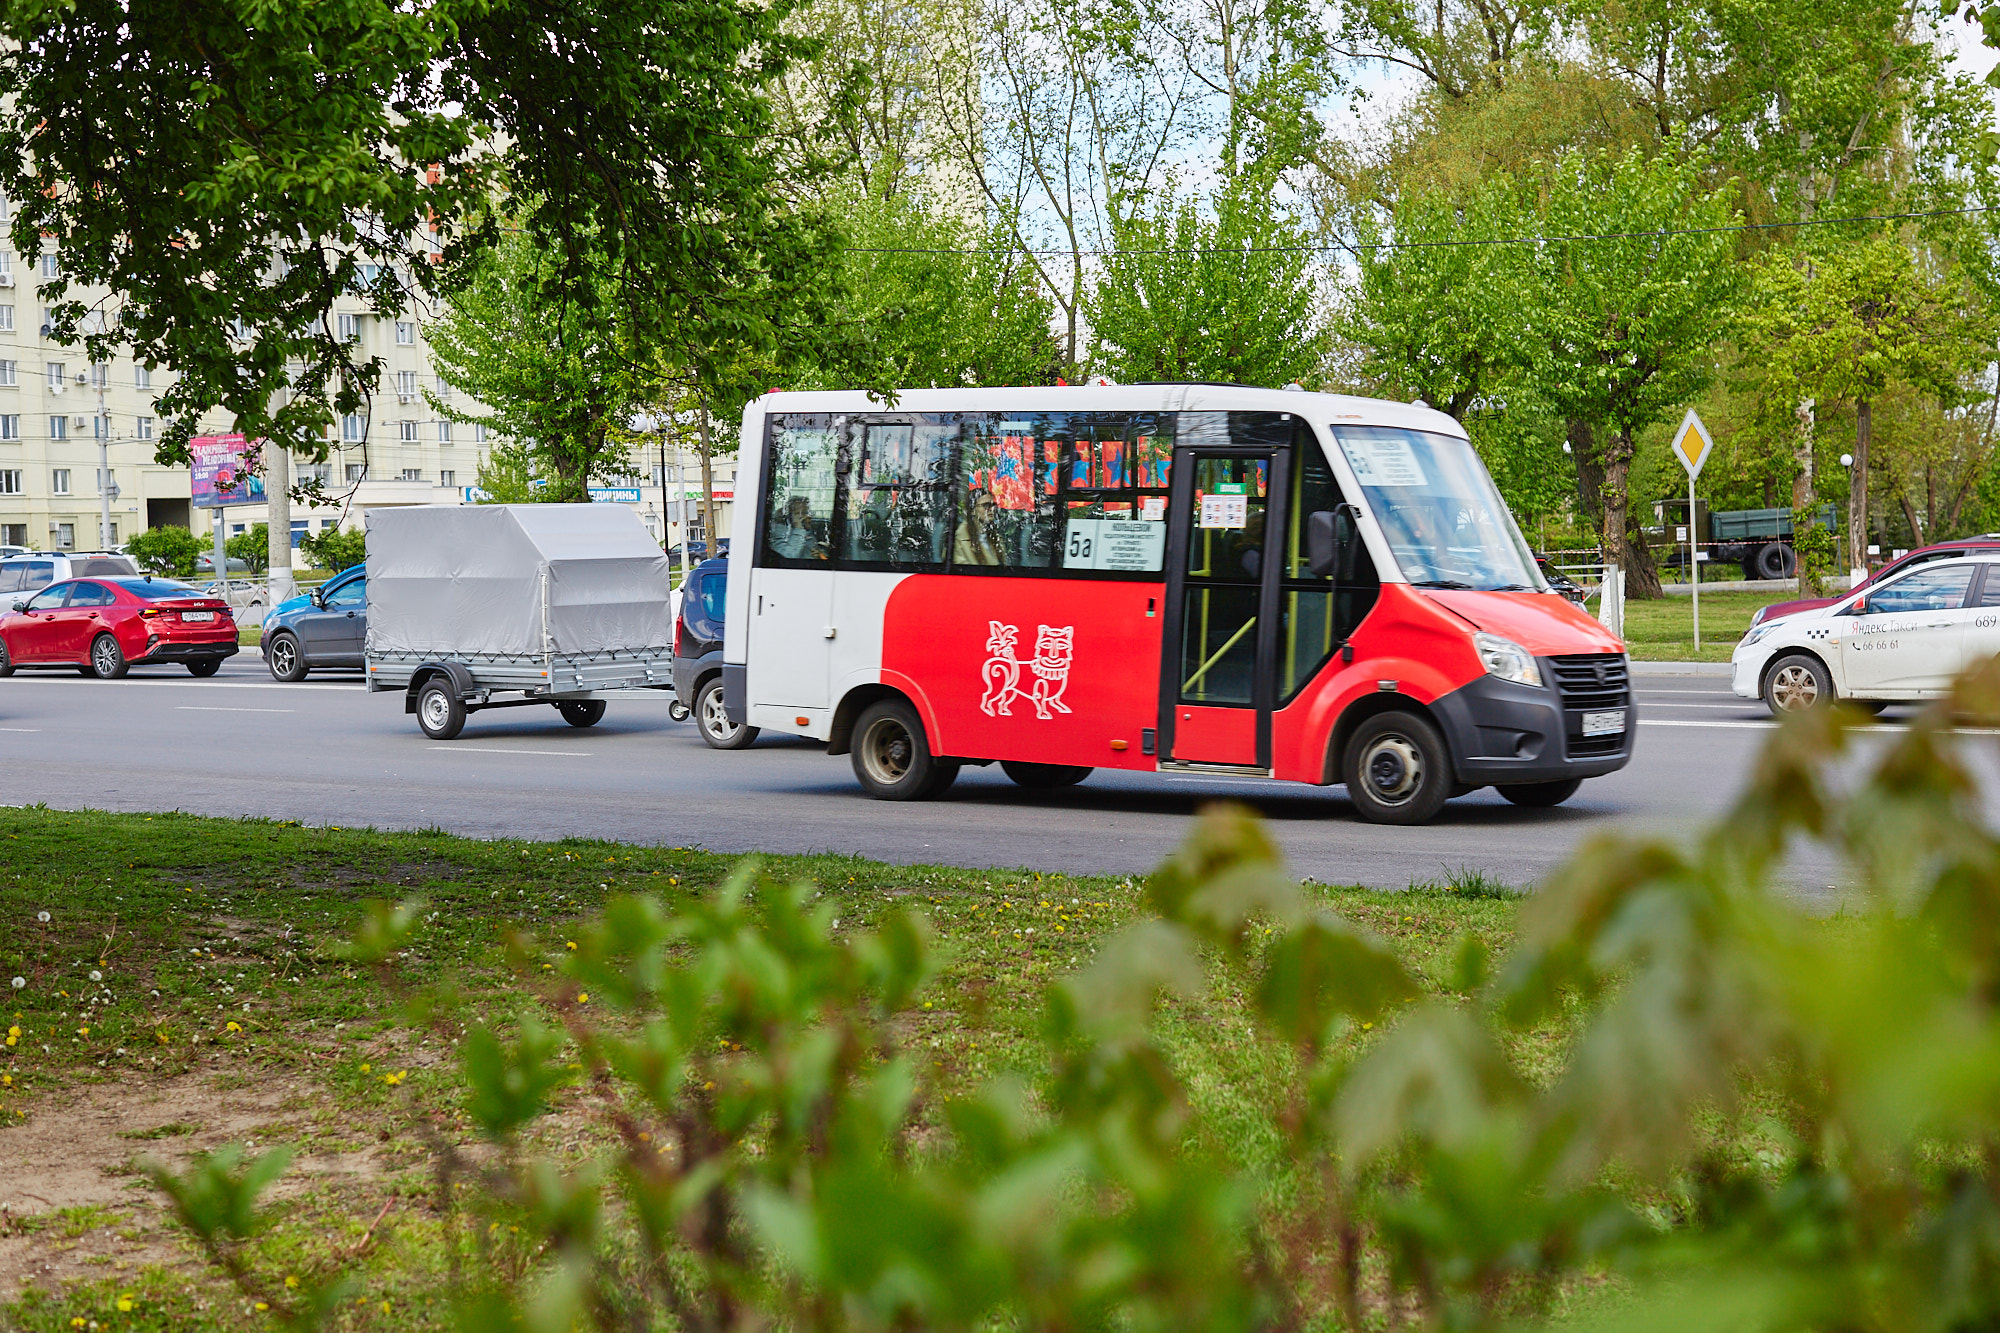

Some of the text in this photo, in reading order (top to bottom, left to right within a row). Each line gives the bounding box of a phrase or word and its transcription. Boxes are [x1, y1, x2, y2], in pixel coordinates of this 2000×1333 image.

[588, 490, 637, 502] ЕДИЦИНЫ
[1852, 619, 1918, 635] Яндекс Такси
[1975, 615, 1996, 627] 689
[1863, 640, 1899, 651] 66 66 61
